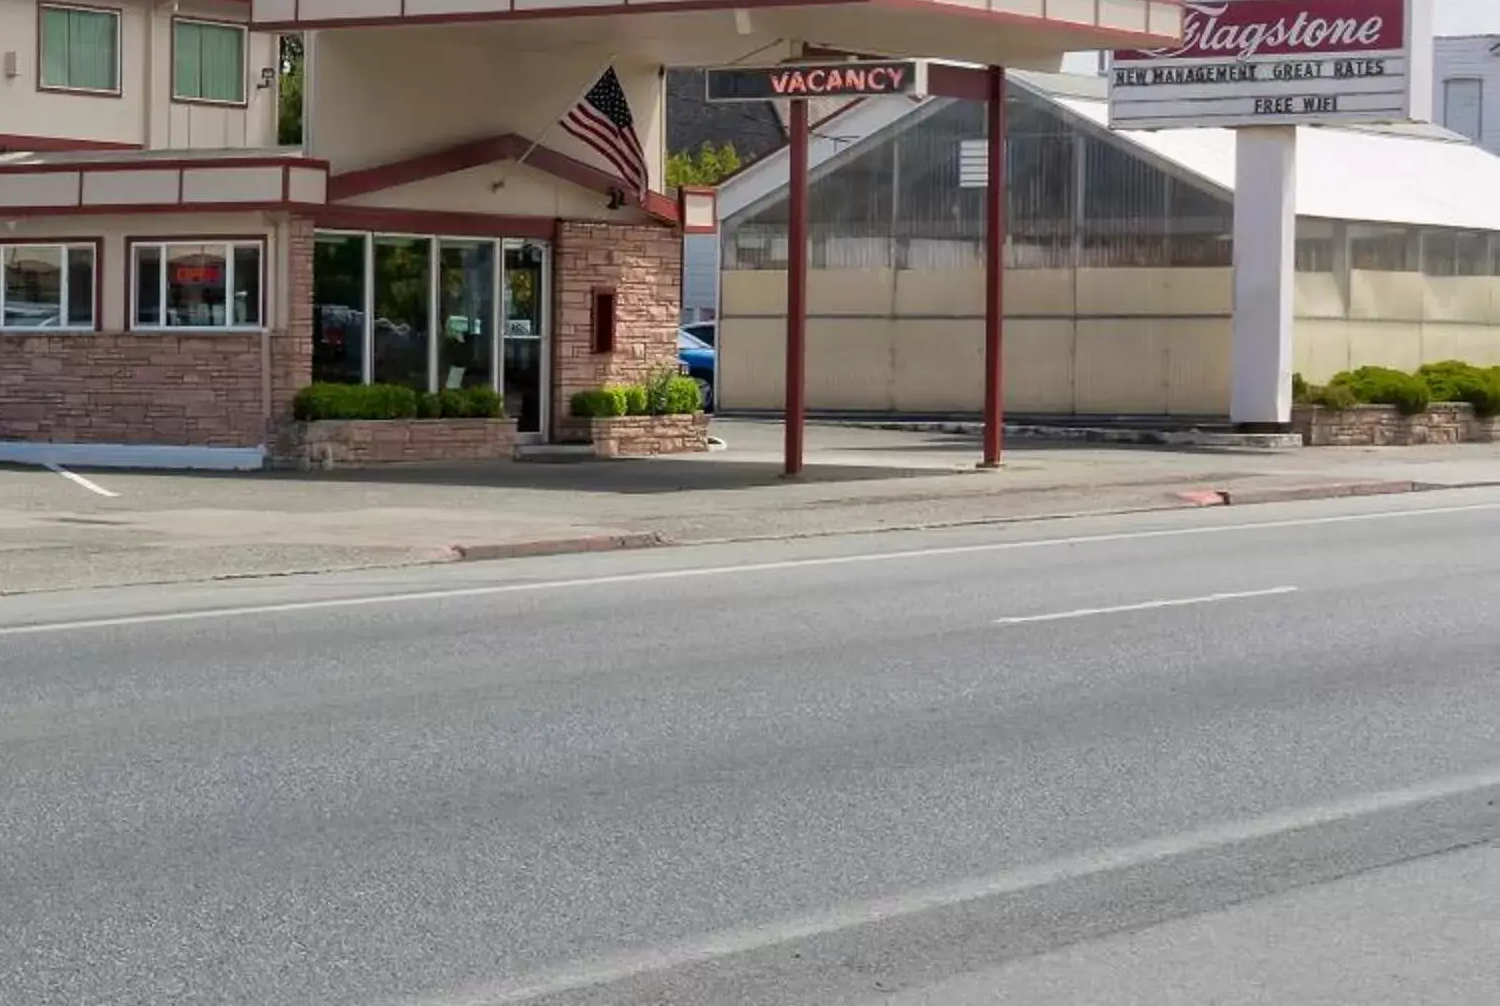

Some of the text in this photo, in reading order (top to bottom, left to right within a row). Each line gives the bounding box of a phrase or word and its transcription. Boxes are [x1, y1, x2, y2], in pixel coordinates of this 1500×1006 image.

[770, 68, 904, 93] VACANCY
[1116, 61, 1384, 86] NEW MANAGEMENT GREAT RATES
[1255, 96, 1338, 113] FREE WIFI
